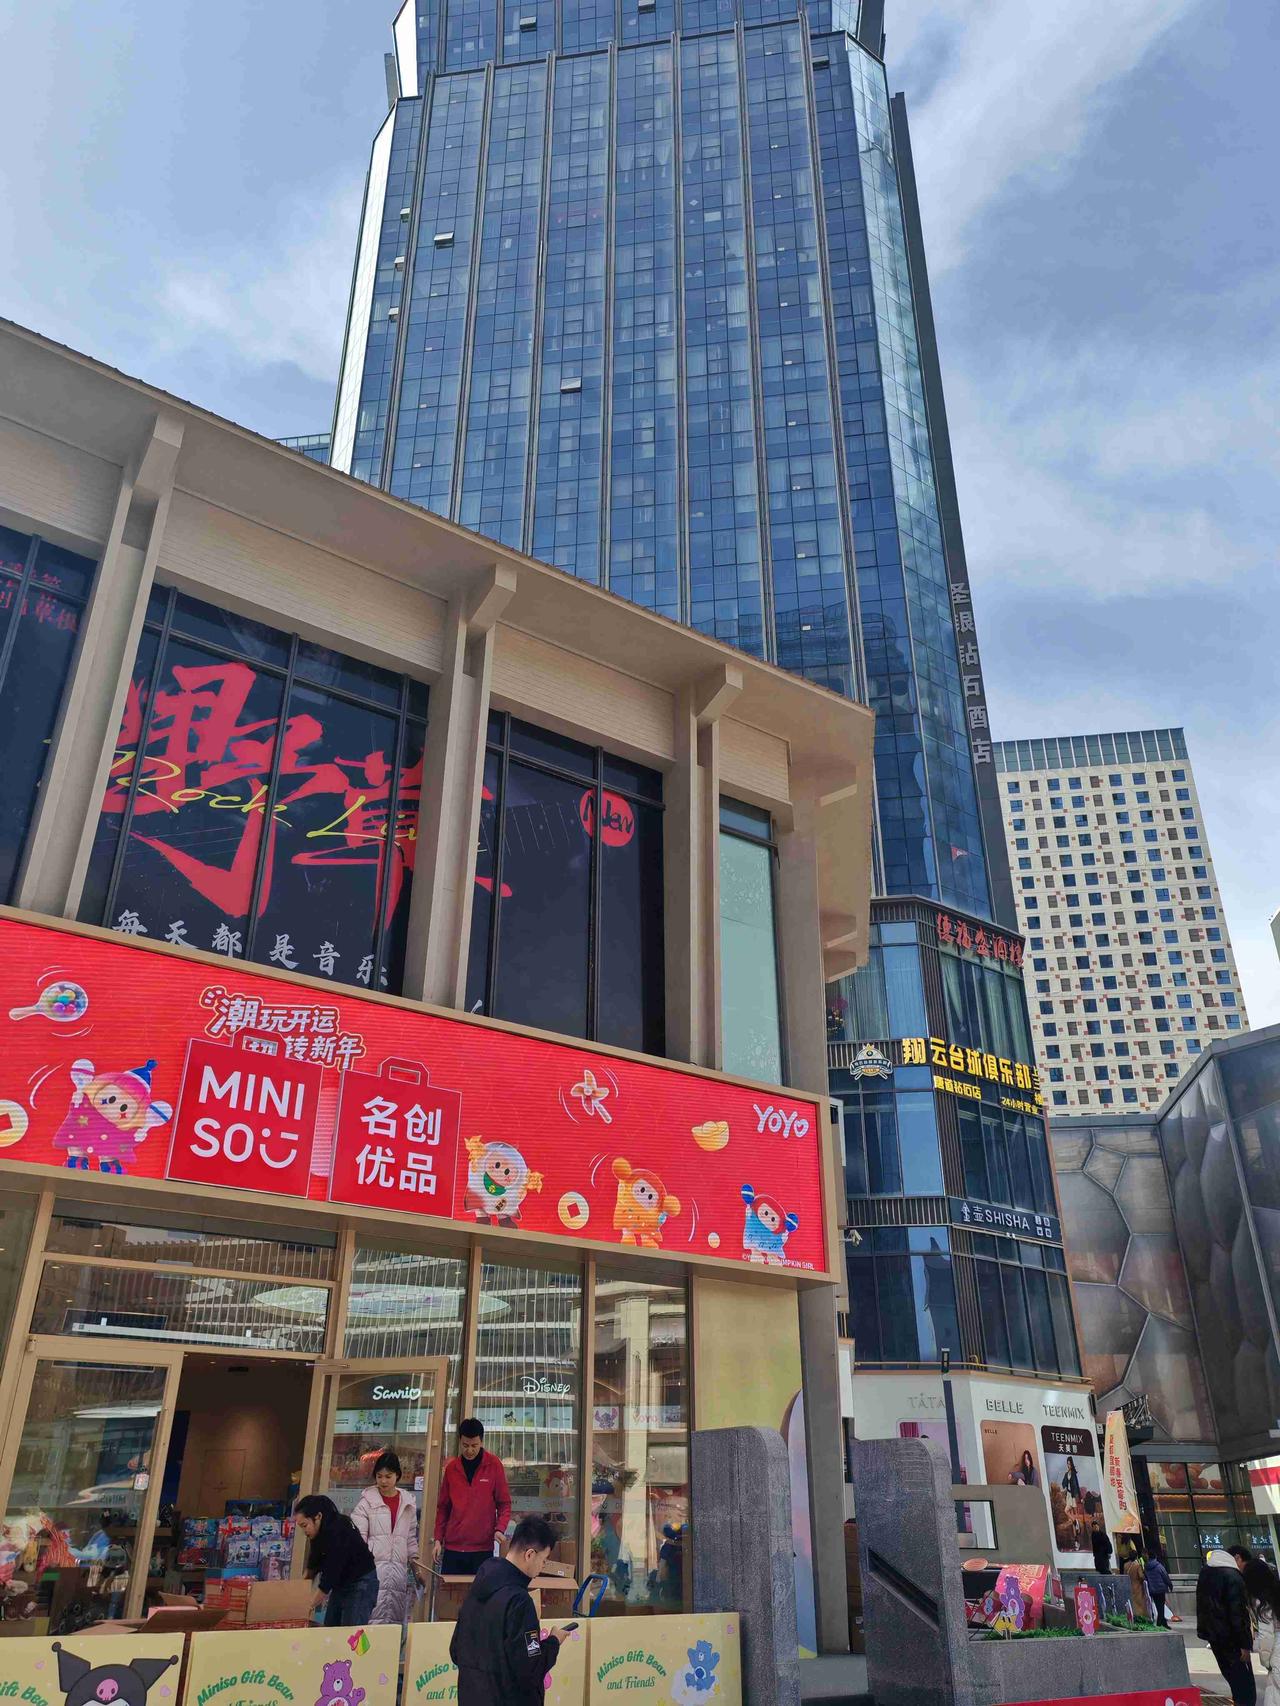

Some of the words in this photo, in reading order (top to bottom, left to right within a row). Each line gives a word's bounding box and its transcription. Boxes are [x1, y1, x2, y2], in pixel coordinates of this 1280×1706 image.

[202, 994, 336, 1034] 潮玩开运
[902, 1037, 1032, 1090] 翔云台球俱乐部
[198, 1065, 305, 1121] MINI
[361, 1095, 442, 1146] 名创
[355, 1144, 437, 1195] 优品
[985, 1399, 1025, 1415] BELLE
[1042, 1404, 1086, 1420] TEENMIX
[1050, 1431, 1084, 1444] TEENMIX
[415, 1664, 450, 1692] Miniso
[597, 1655, 625, 1683] Miniso
[626, 1650, 645, 1663] Gift
[646, 1654, 667, 1677] Bear
[606, 1679, 623, 1690] and
[625, 1676, 656, 1689] Friends
[197, 1676, 238, 1706] Miniso
[241, 1670, 266, 1685] Gift
[267, 1674, 294, 1701] Bear
[426, 1688, 447, 1700] and
